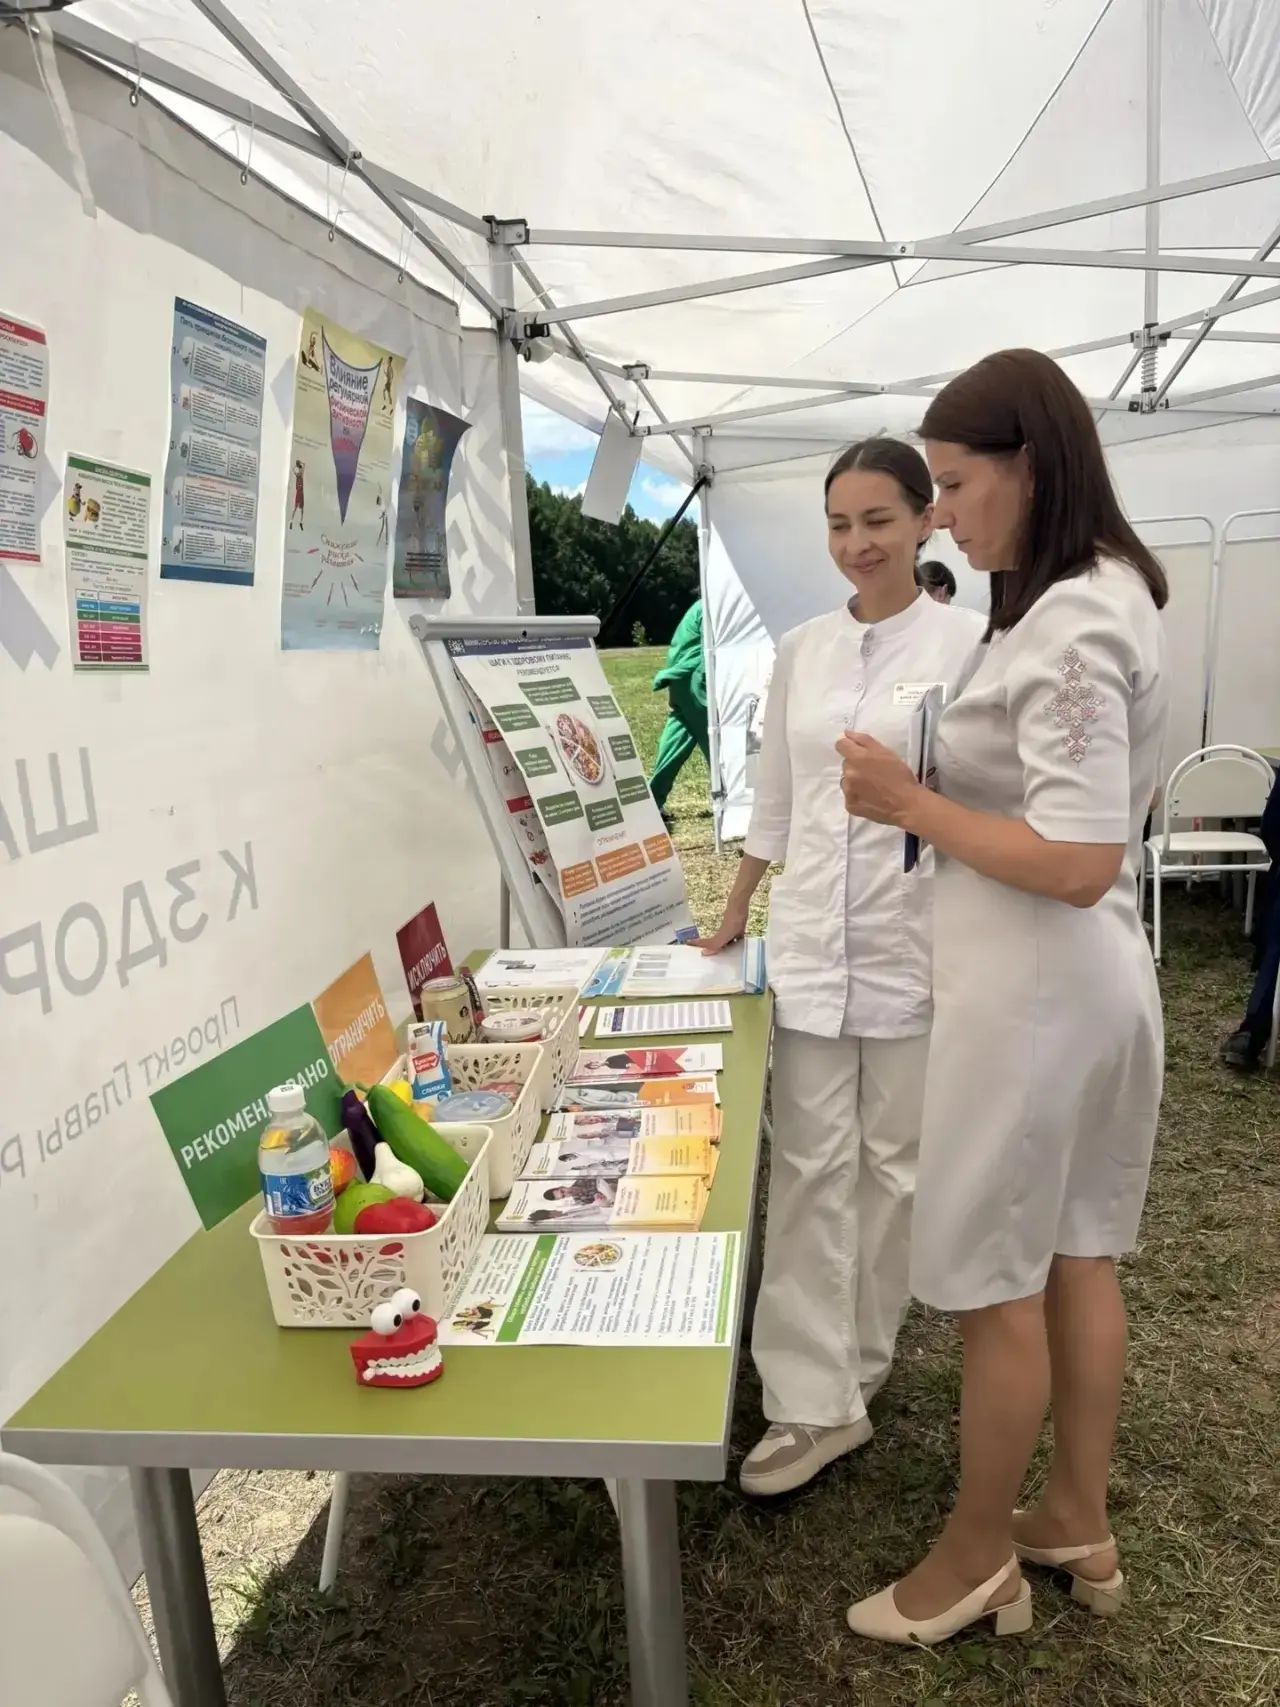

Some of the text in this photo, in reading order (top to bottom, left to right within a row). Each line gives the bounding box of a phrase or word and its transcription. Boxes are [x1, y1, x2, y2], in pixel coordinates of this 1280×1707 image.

[329, 355, 368, 390] Влияние
[329, 379, 369, 406] регулярной
[407, 942, 447, 992] ИСКЛЮЧИТЬ
[328, 998, 386, 1066] ОГРАНИЧИТЬ
[180, 1057, 329, 1170] РЕКОМЕНВАНО
